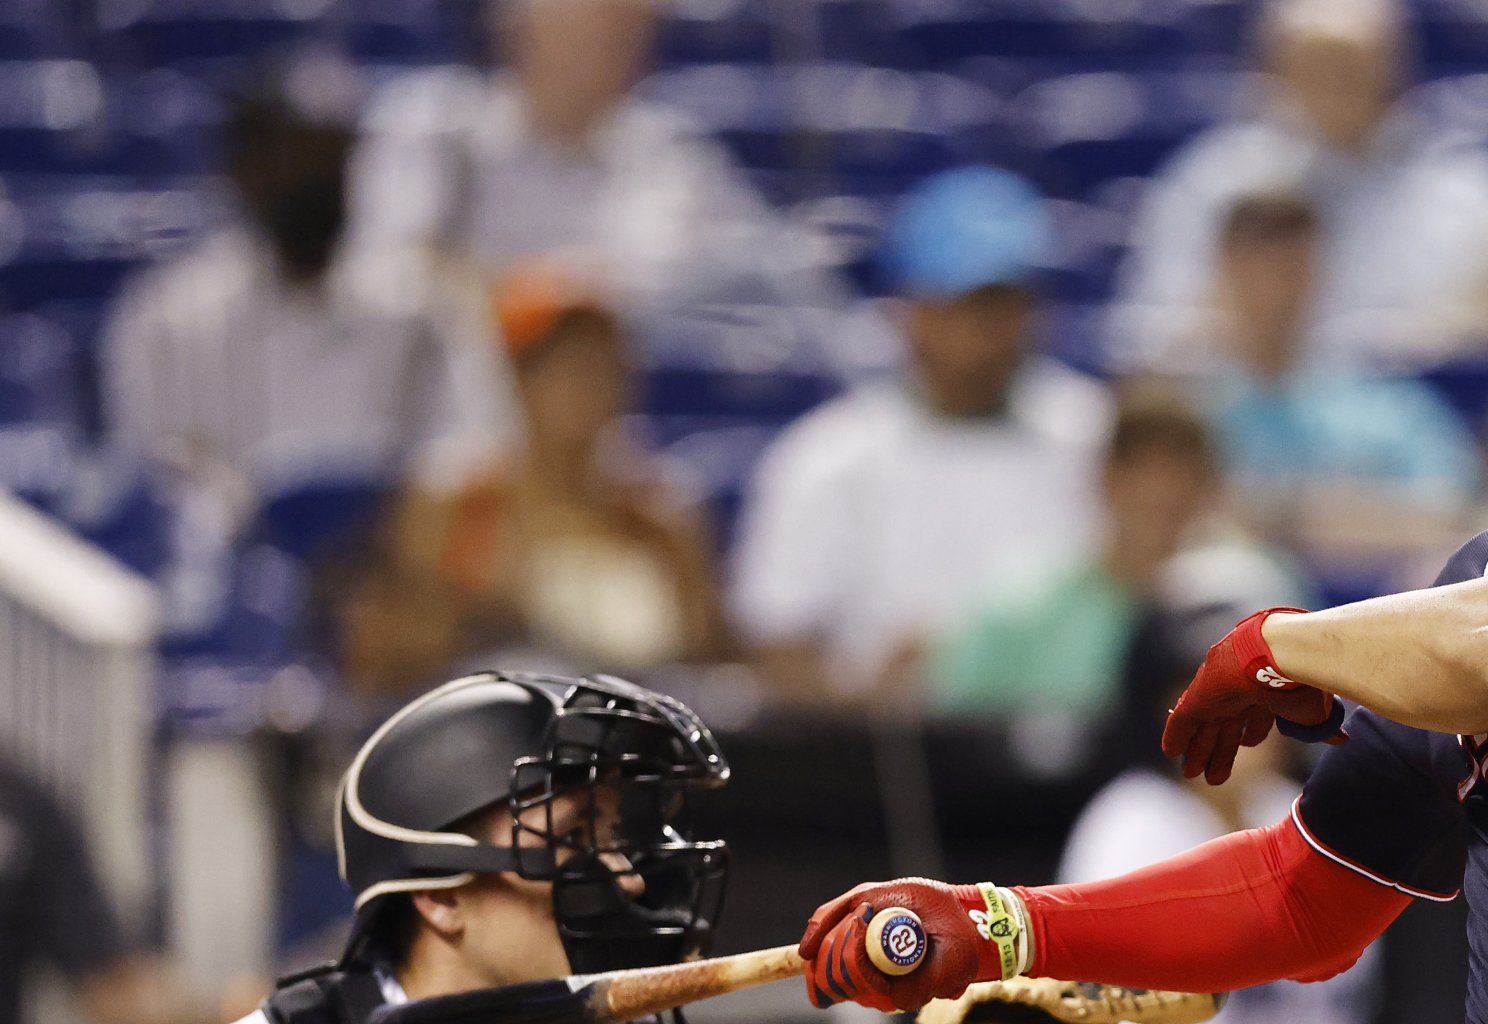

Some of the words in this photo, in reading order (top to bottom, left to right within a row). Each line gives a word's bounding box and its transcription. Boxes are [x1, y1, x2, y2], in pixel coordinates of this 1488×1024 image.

[882, 917, 918, 947] WASHINGTON
[891, 928, 916, 954] 22
[893, 939, 925, 965] NATIONALS
